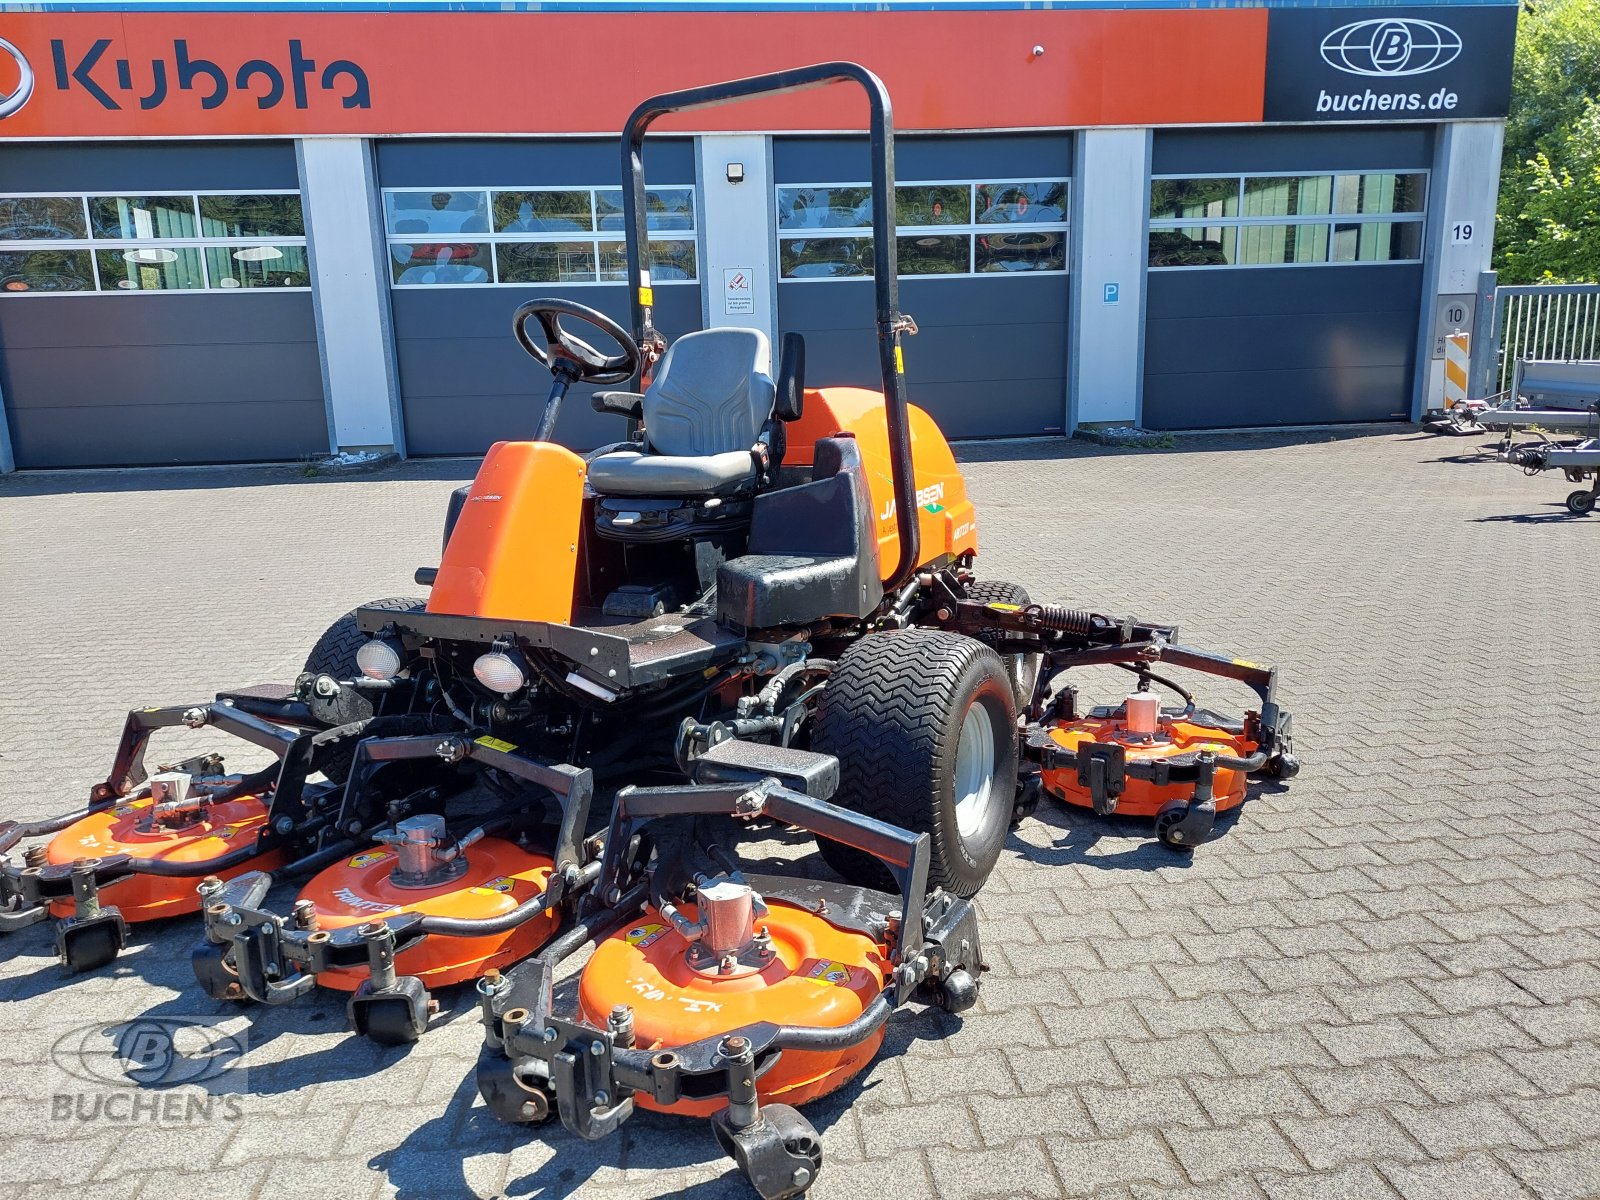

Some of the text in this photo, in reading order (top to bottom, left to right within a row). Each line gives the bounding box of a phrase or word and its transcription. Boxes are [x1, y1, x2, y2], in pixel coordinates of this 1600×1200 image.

[50, 38, 372, 111] Kubota
[1316, 87, 1459, 112] buchens.de
[1453, 224, 1473, 241] 19
[1105, 284, 1118, 301] P
[1448, 308, 1463, 323] 10
